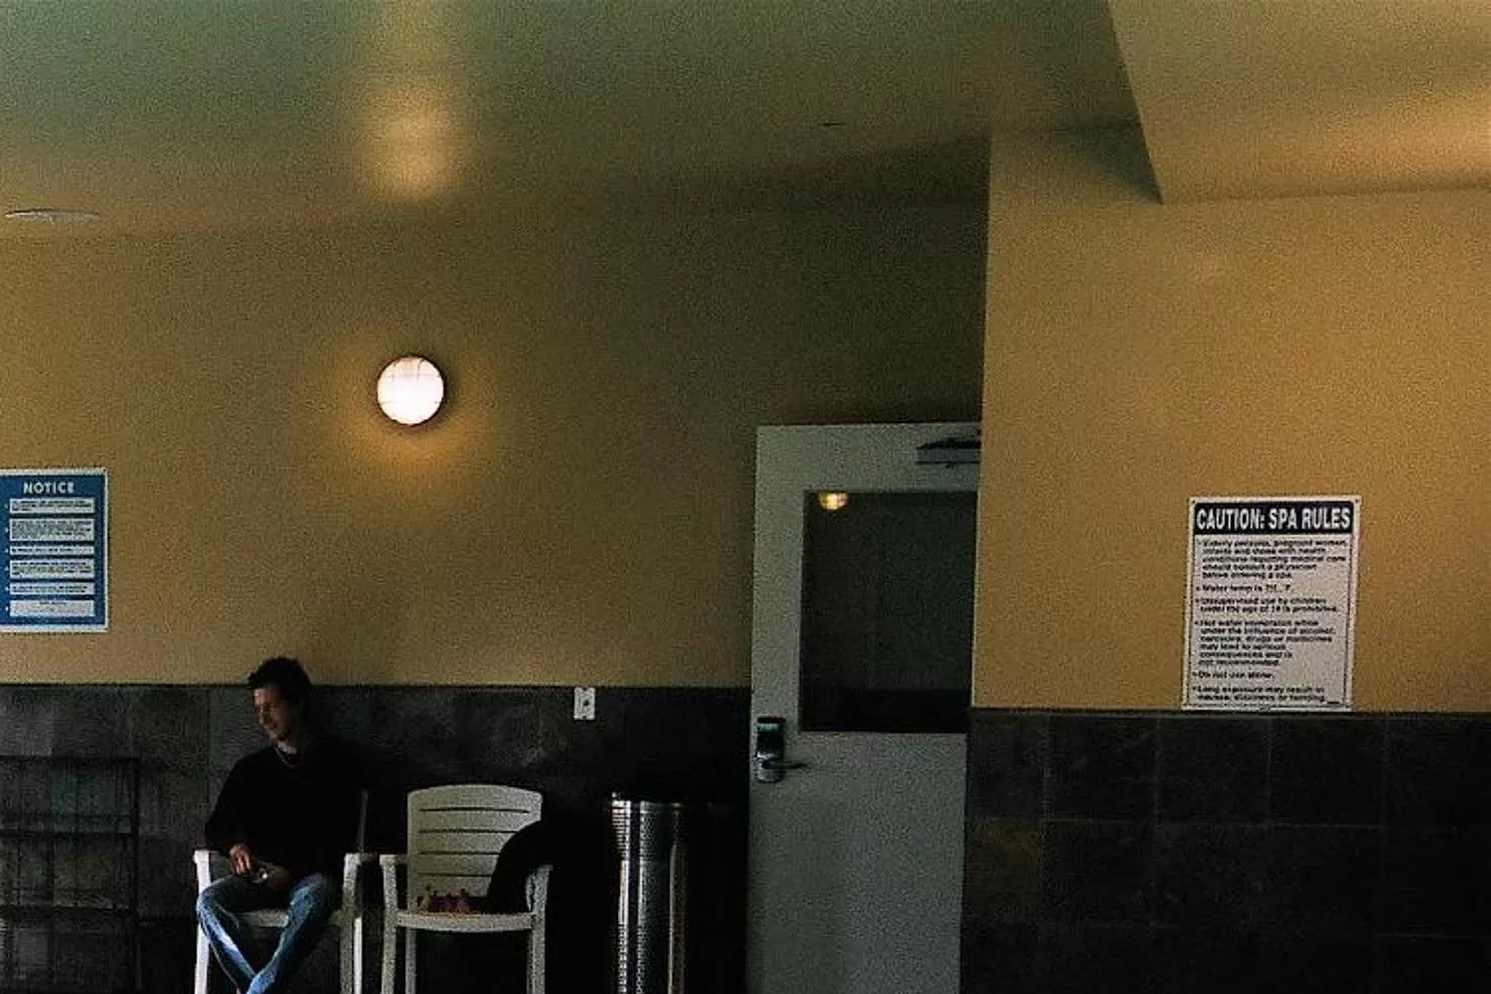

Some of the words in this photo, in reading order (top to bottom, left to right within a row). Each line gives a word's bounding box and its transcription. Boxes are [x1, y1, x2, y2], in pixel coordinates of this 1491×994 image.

[23, 482, 74, 494] NOTICE
[1196, 508, 1265, 530] CAUTION:
[1268, 508, 1297, 529] SPA
[1301, 507, 1351, 529] RULES
